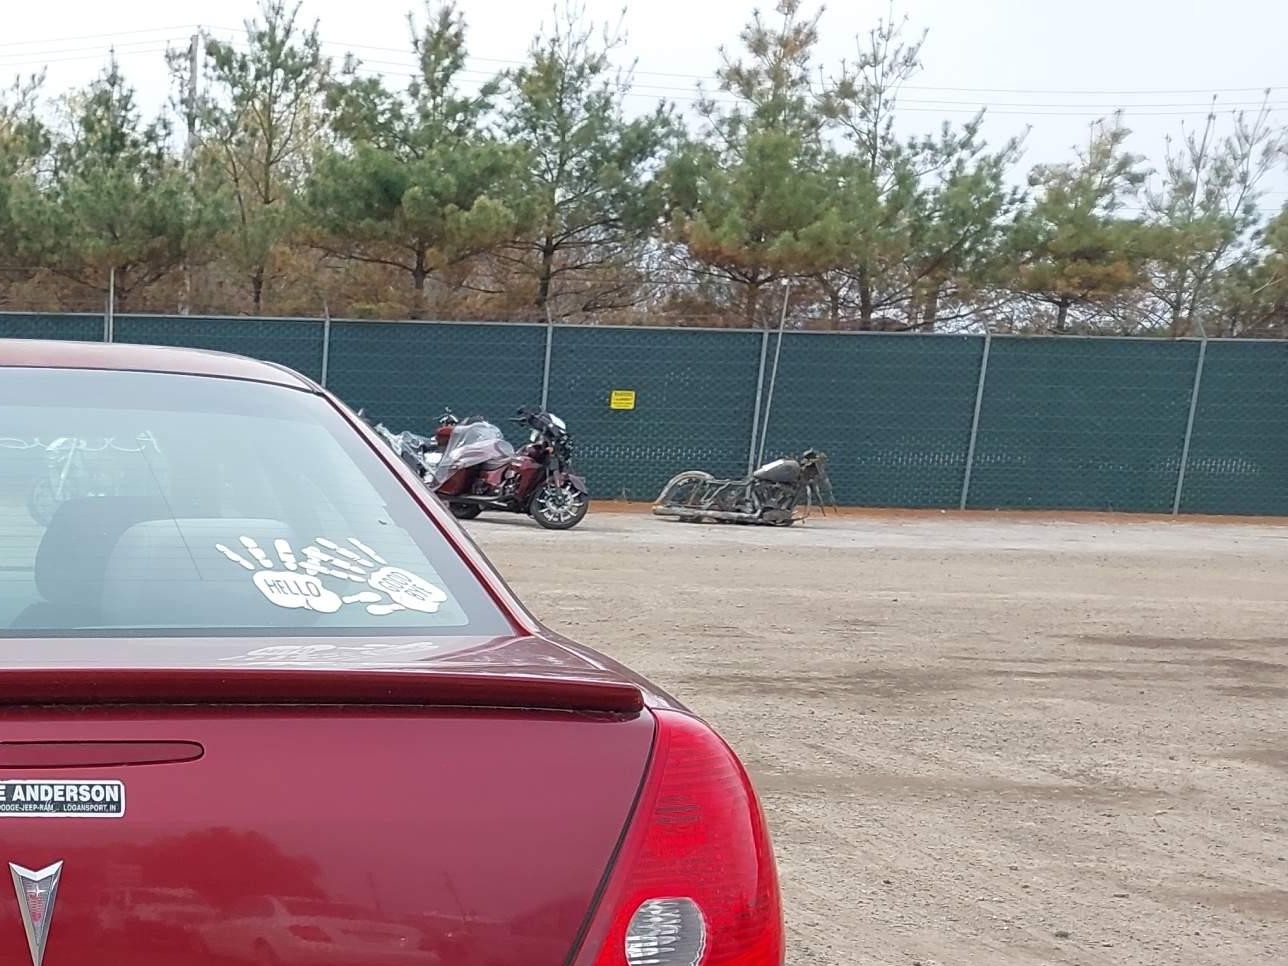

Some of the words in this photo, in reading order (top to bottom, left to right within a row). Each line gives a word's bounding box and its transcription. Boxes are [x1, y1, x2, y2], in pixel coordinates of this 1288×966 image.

[263, 578, 321, 598] HELLO
[11, 784, 119, 802] ANDERSON
[110, 803, 117, 812] IN
